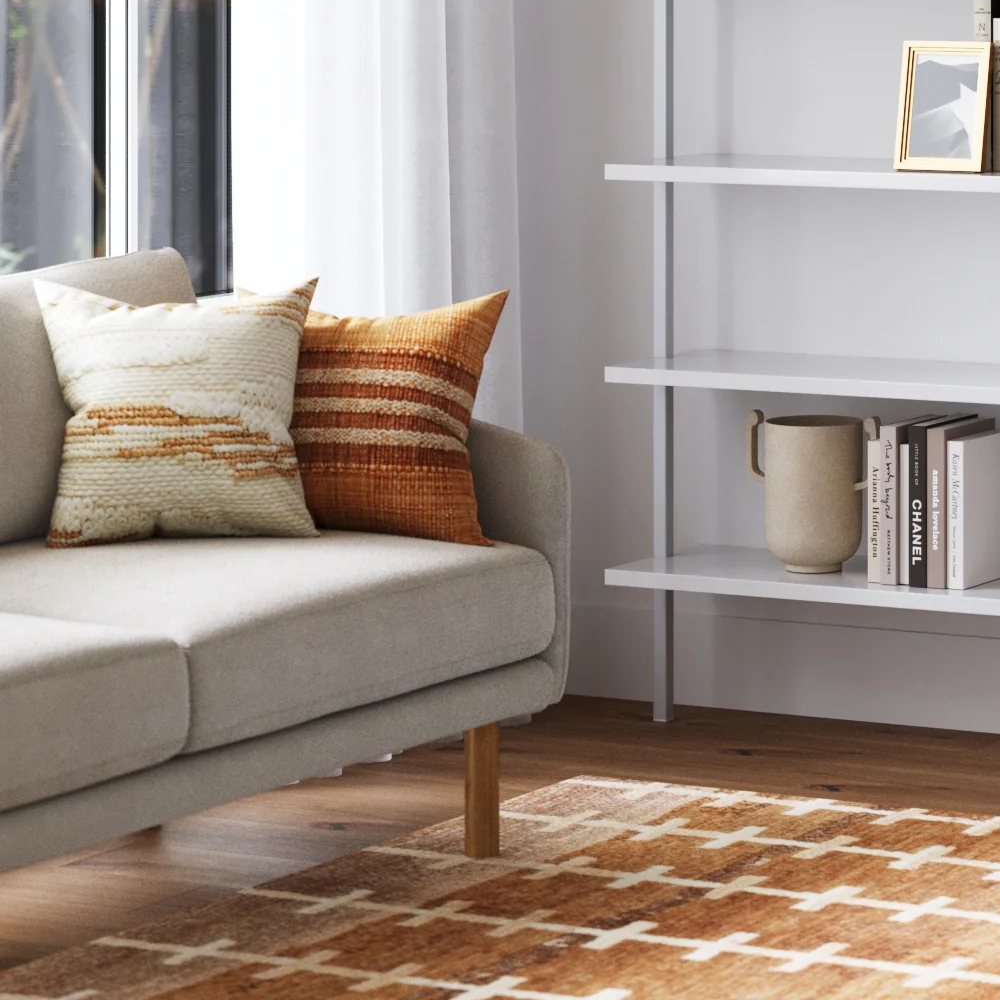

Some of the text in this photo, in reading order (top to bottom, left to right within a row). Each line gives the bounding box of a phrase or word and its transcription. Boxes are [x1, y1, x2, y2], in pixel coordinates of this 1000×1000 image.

[978, 23, 986, 32] N
[952, 454, 960, 476] Karen
[950, 479, 960, 520] McCartney
[871, 507, 880, 558] Huffington
[912, 499, 922, 565] CHANEL
